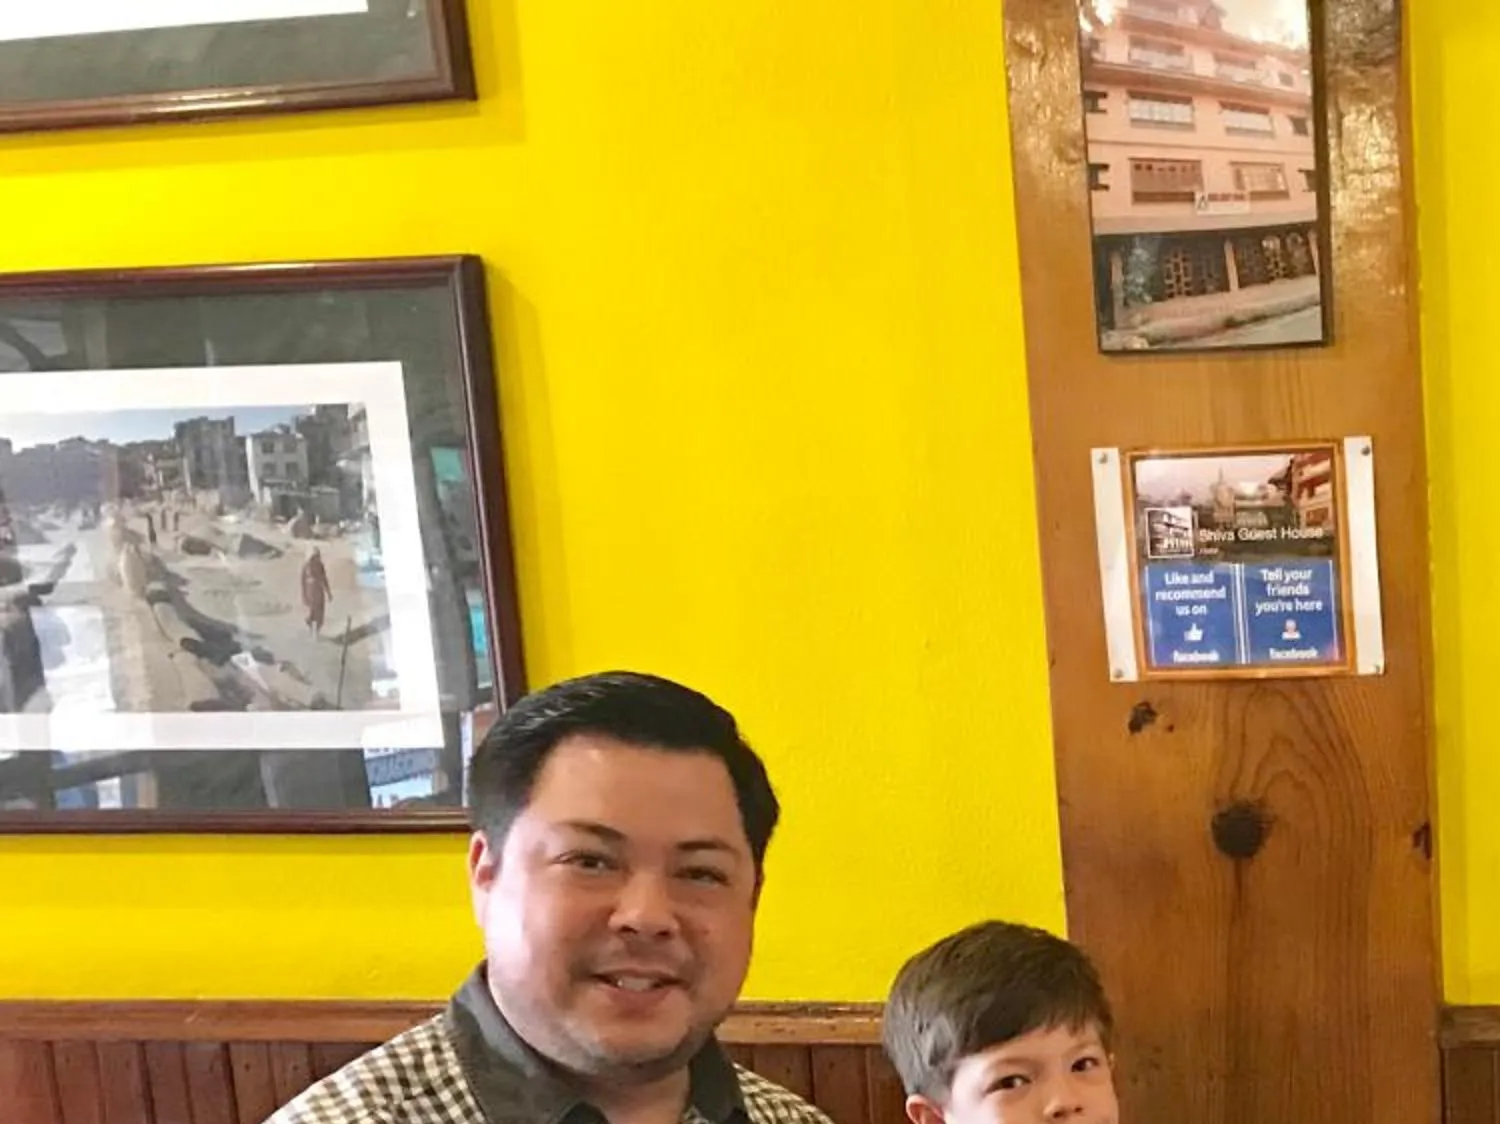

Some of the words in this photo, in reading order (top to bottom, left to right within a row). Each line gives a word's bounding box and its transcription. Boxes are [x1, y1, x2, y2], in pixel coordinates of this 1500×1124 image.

[1199, 527, 1235, 542] Shiva
[1238, 527, 1277, 541] Guest
[1280, 525, 1323, 539] House
[1164, 571, 1189, 585] Like
[1191, 569, 1215, 584] and
[1260, 568, 1282, 582] Tell
[1284, 568, 1313, 584] your
[1155, 585, 1227, 601] recommend
[1266, 582, 1310, 597] friends
[1175, 604, 1190, 616] us
[1191, 603, 1207, 616] on
[1255, 600, 1293, 616] you're
[1295, 597, 1323, 612] here
[1172, 648, 1220, 663] facebook
[1269, 645, 1318, 660] facebook
